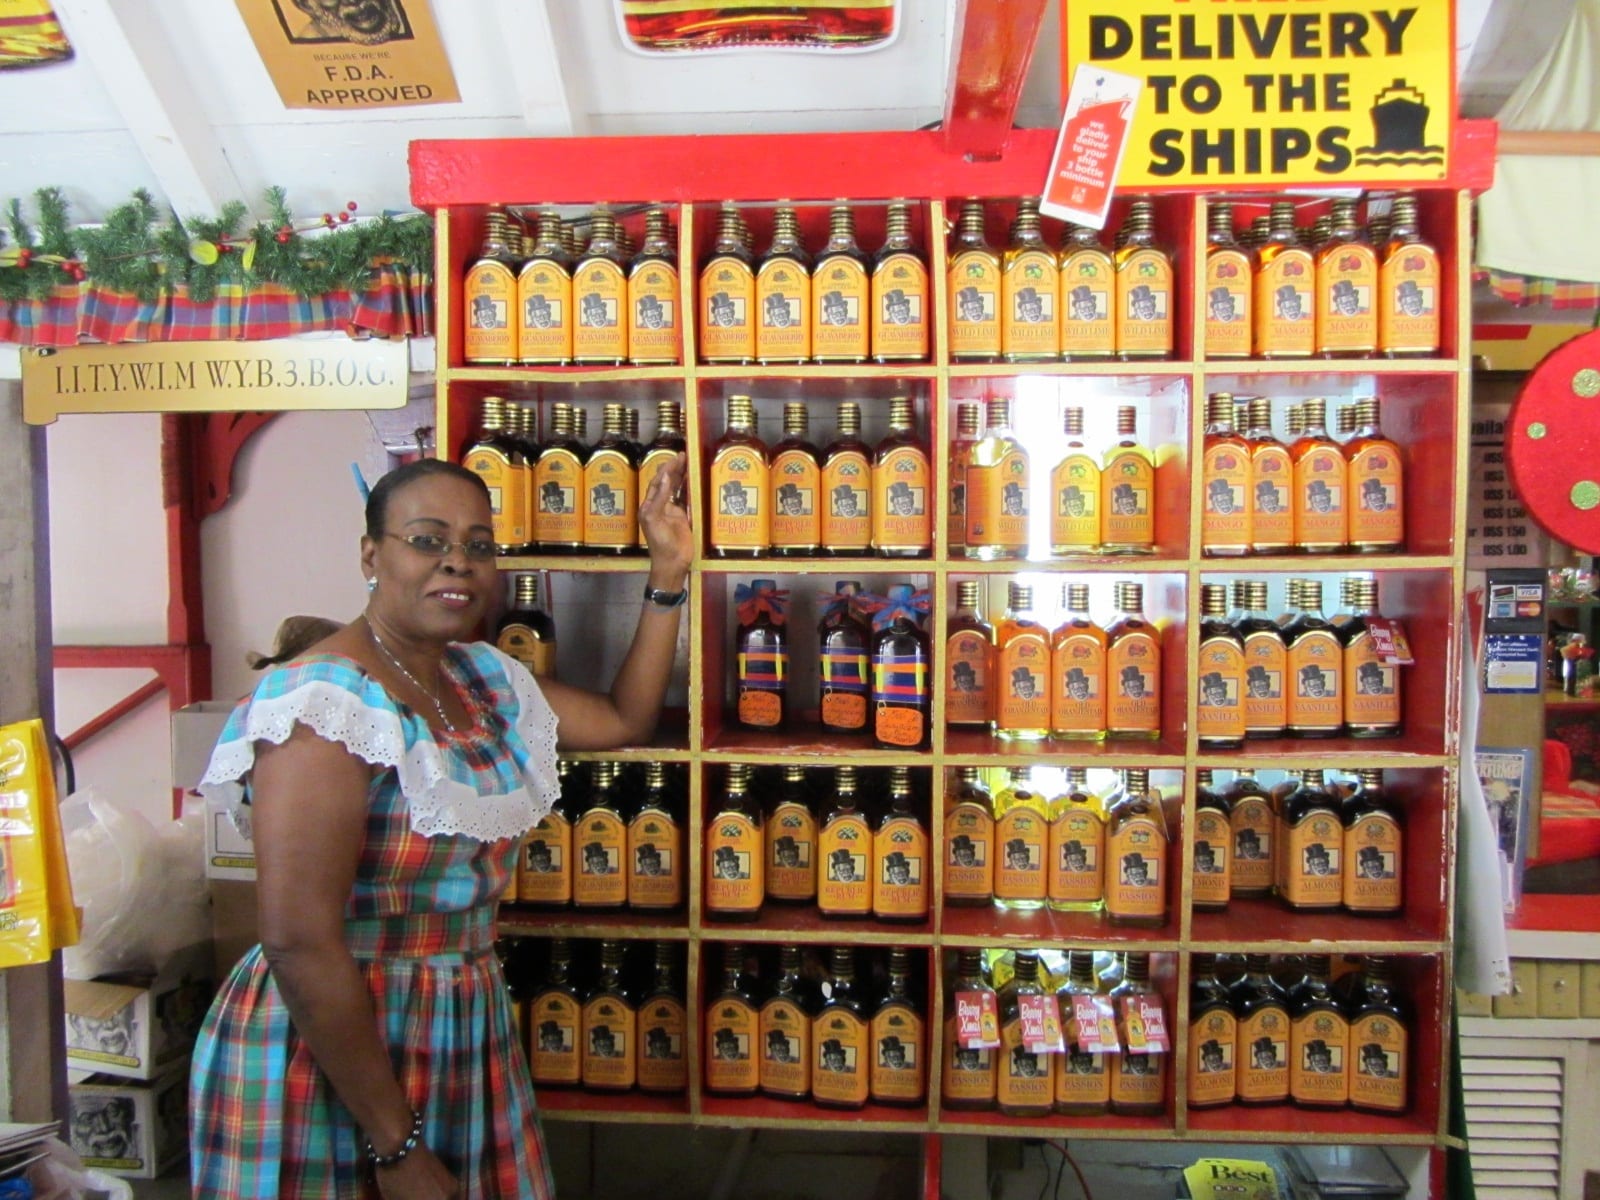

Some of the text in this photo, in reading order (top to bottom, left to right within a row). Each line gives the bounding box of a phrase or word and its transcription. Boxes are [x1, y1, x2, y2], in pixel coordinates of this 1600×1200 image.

[1089, 8, 1418, 61] DELIVERY
[325, 64, 394, 82] F.D.A.
[307, 84, 432, 104] APPROVED
[1147, 73, 1352, 115] TO THE
[1080, 127, 1109, 141] gladly
[1090, 121, 1104, 129] we
[1073, 144, 1107, 160] to your
[1076, 136, 1109, 150] deliver
[1147, 125, 1353, 176] SHIPS
[1078, 155, 1098, 167] ship
[1060, 170, 1105, 188] minimum
[1075, 163, 1104, 178] bottle
[1208, 1165, 1270, 1184] Best
